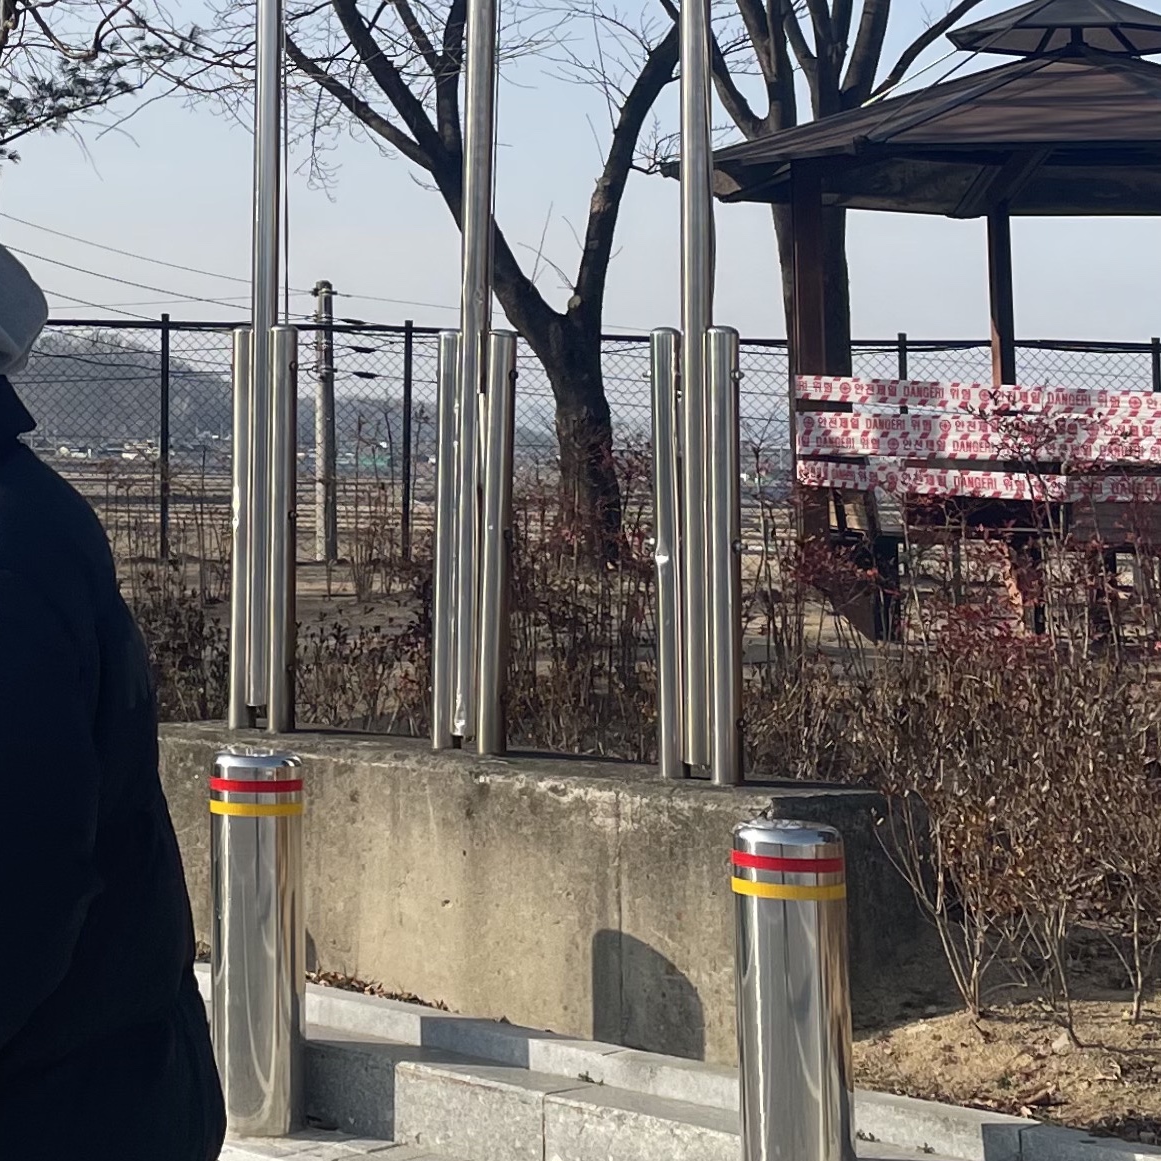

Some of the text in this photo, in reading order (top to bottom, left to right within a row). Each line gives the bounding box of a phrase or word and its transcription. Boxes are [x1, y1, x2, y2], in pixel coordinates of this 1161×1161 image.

[812, 381, 832, 393] 위험
[854, 383, 897, 397] 안전제일
[950, 388, 971, 401] 위험
[817, 417, 859, 430] 안전제일
[911, 419, 932, 432] 위험
[860, 437, 880, 450] 위험
[903, 439, 946, 452] 안전제일
